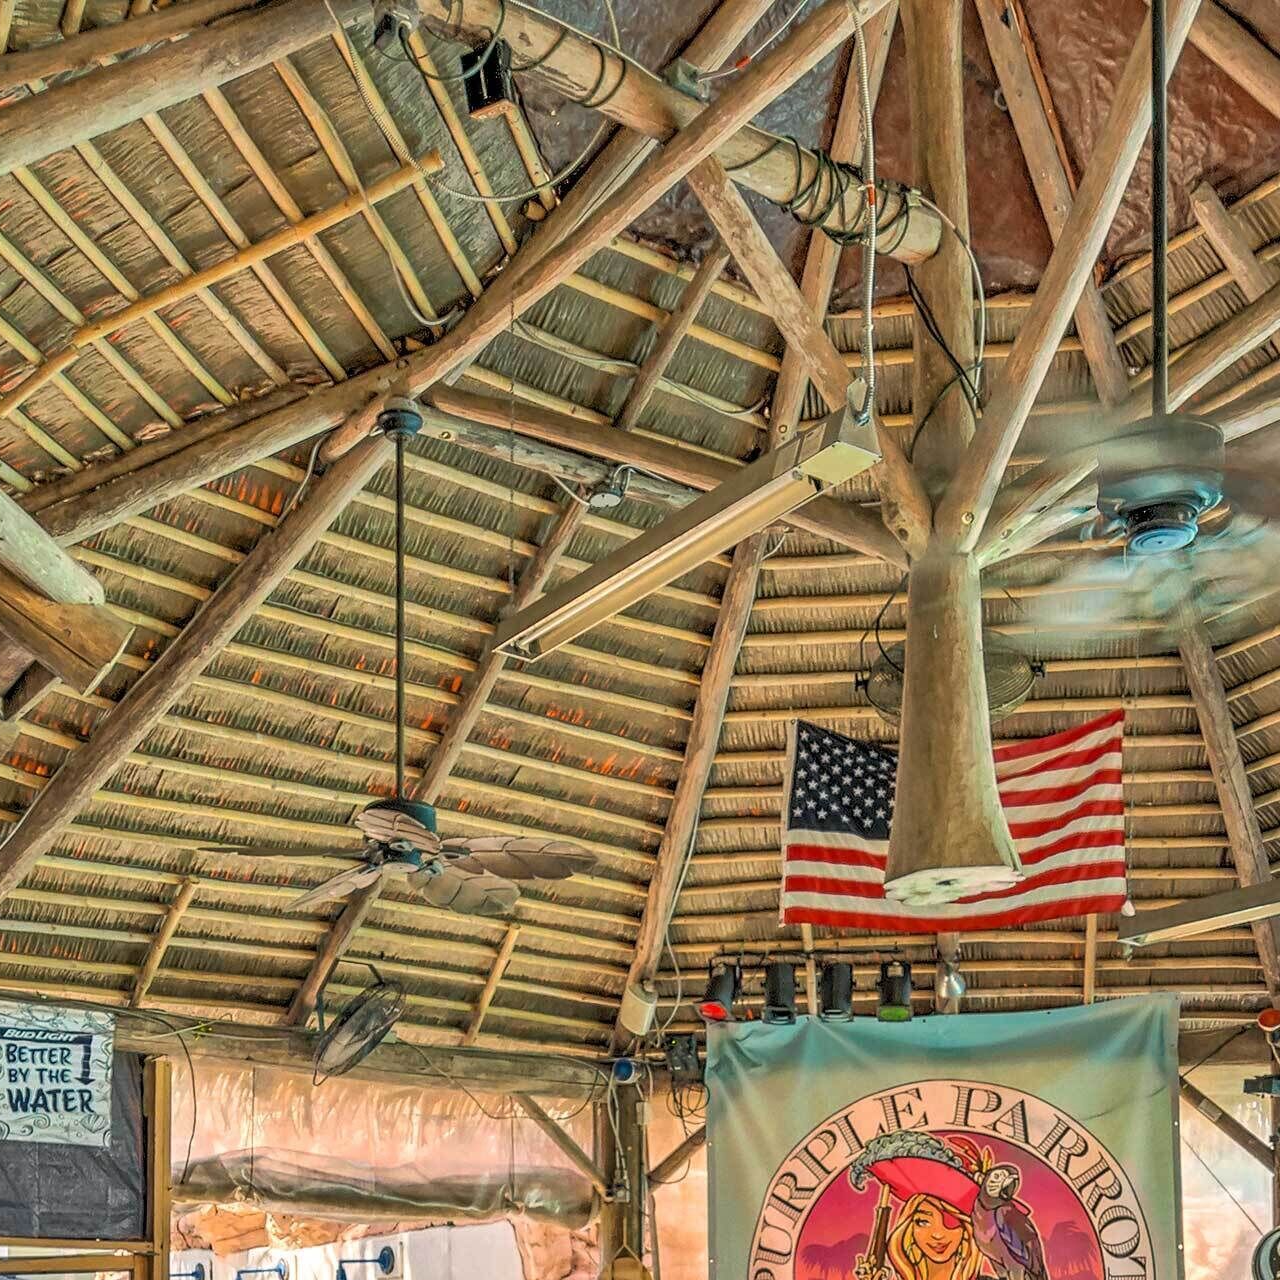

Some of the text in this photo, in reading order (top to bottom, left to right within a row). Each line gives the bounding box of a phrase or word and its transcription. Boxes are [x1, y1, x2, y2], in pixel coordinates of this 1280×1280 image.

[3, 1028, 80, 1042] BUD LIGHT
[6, 1043, 73, 1065] BETTER
[8, 1068, 73, 1084] BY THE
[6, 1087, 96, 1113] WATER
